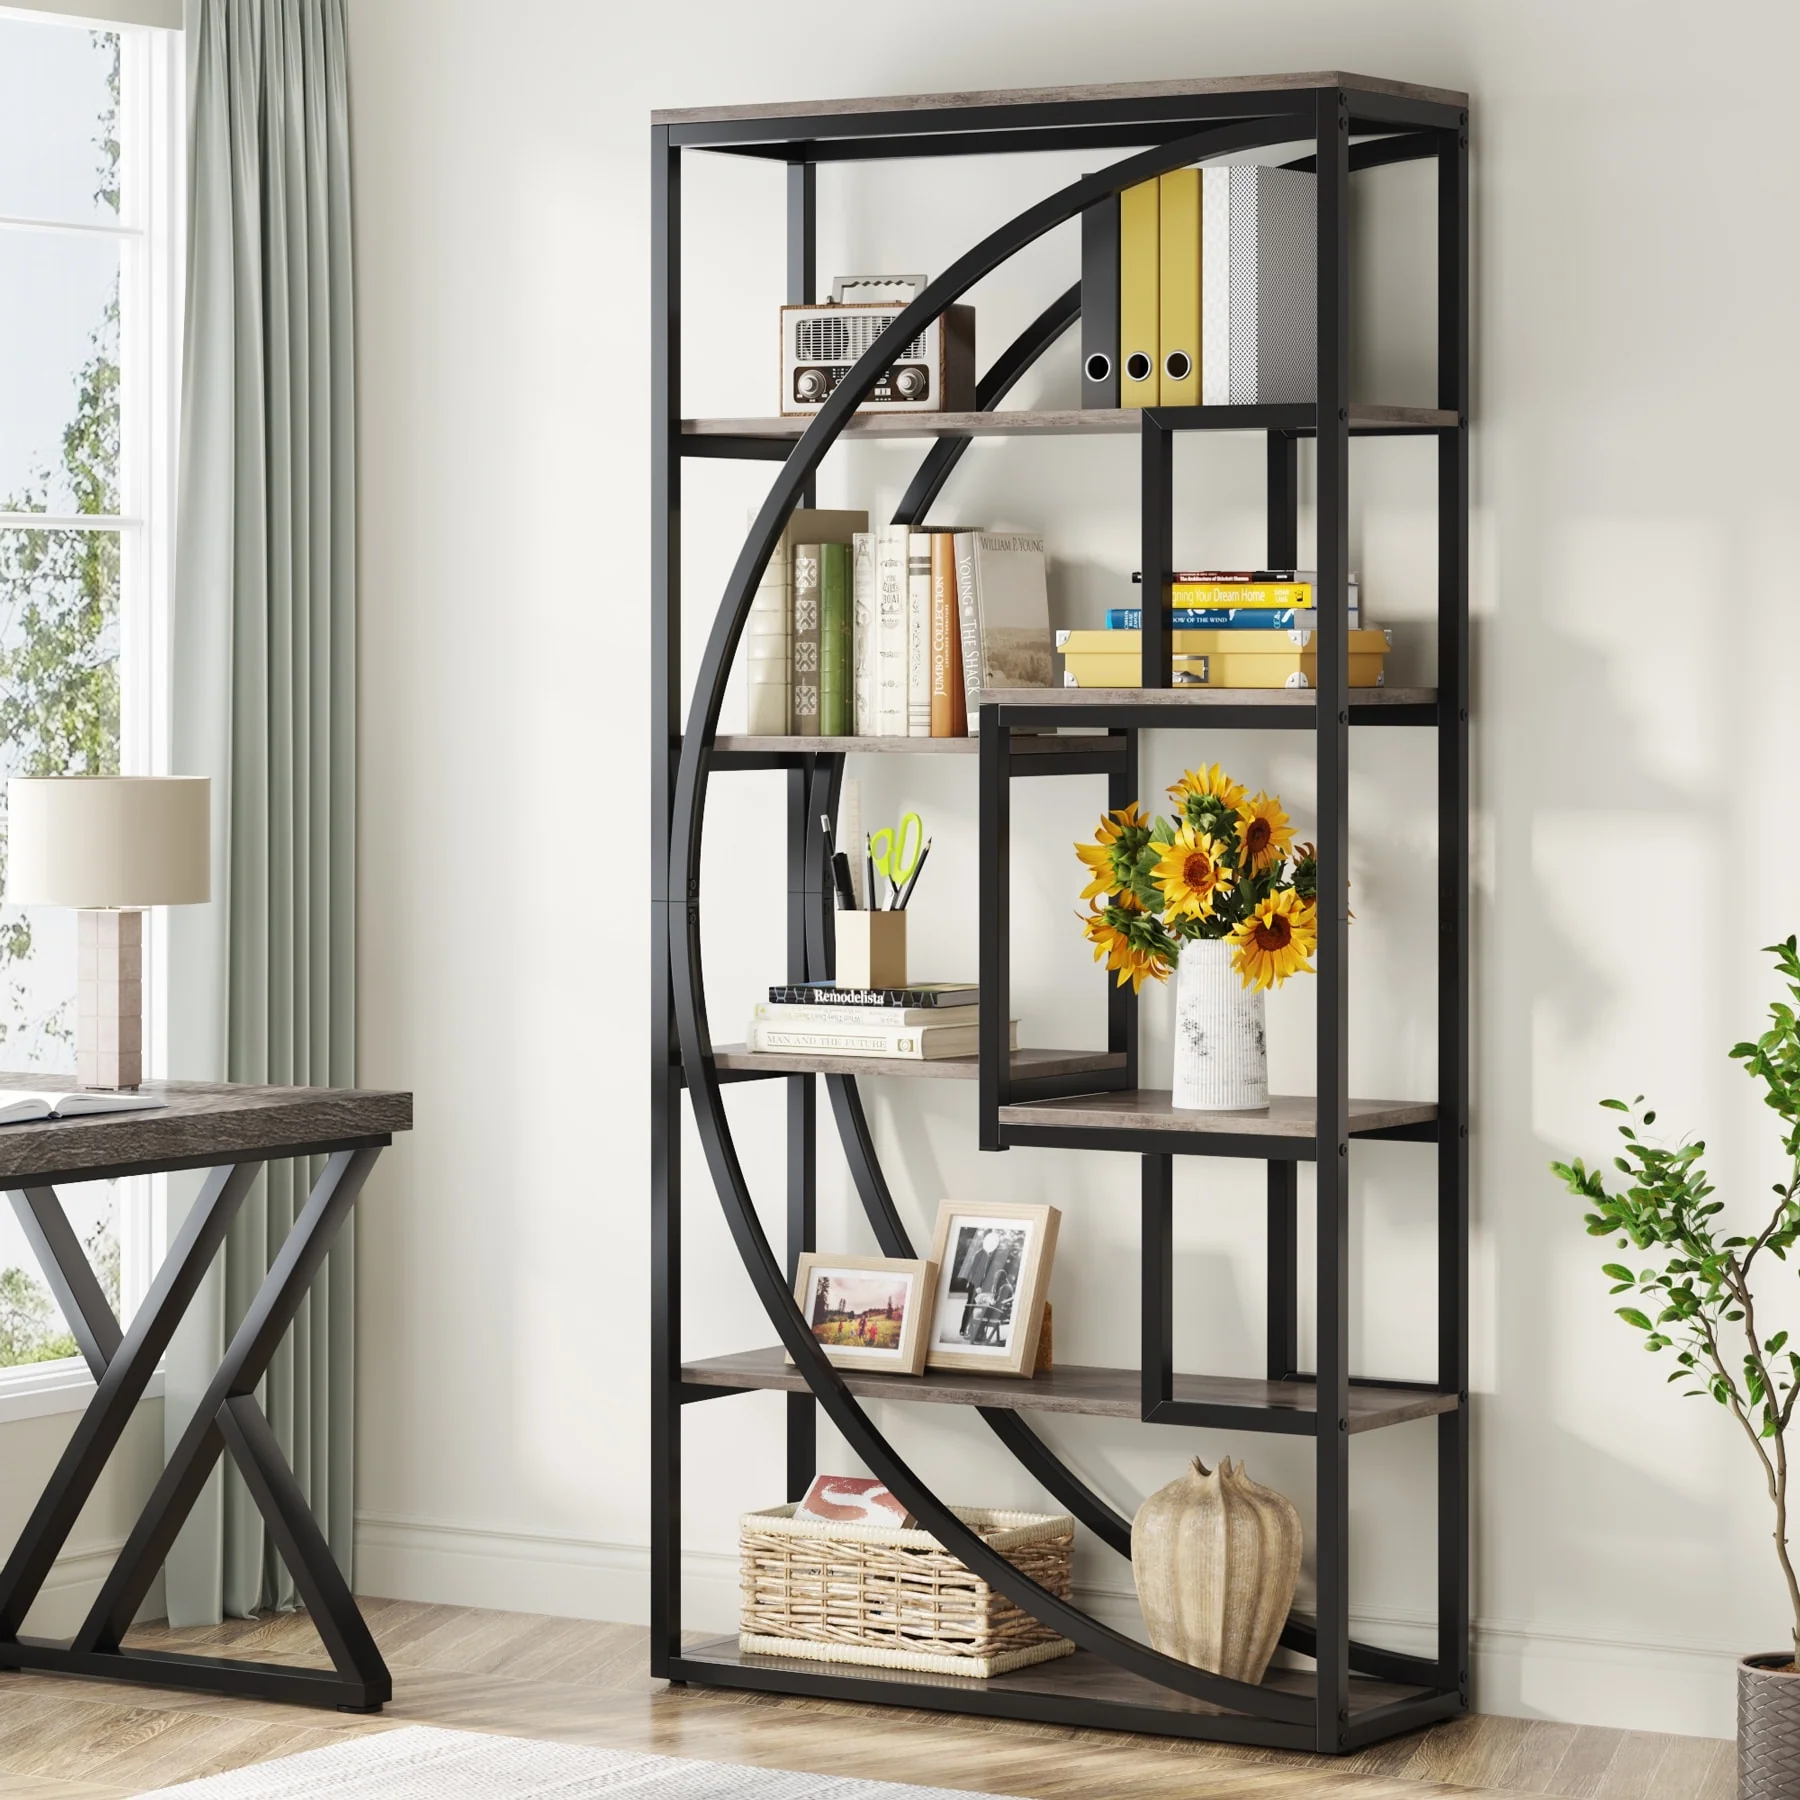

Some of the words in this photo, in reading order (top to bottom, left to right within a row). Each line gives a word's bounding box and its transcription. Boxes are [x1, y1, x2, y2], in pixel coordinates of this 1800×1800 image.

[980, 536, 1012, 551] WILLIAM
[1019, 537, 1044, 552] YOUNG
[959, 556, 973, 605] YOUNG
[1195, 589, 1213, 602] Your
[1214, 588, 1239, 602] Dream
[1241, 588, 1265, 602] Home
[933, 576, 944, 652] COLLECTION
[961, 619, 977, 646] THE
[934, 655, 947, 696] JUMBO
[964, 651, 980, 696] SHACK
[814, 989, 884, 1004] Remodelista
[767, 1034, 791, 1044] MAN
[794, 1035, 817, 1045] AND
[820, 1036, 841, 1046] THE
[844, 1038, 887, 1048] FUTURE
